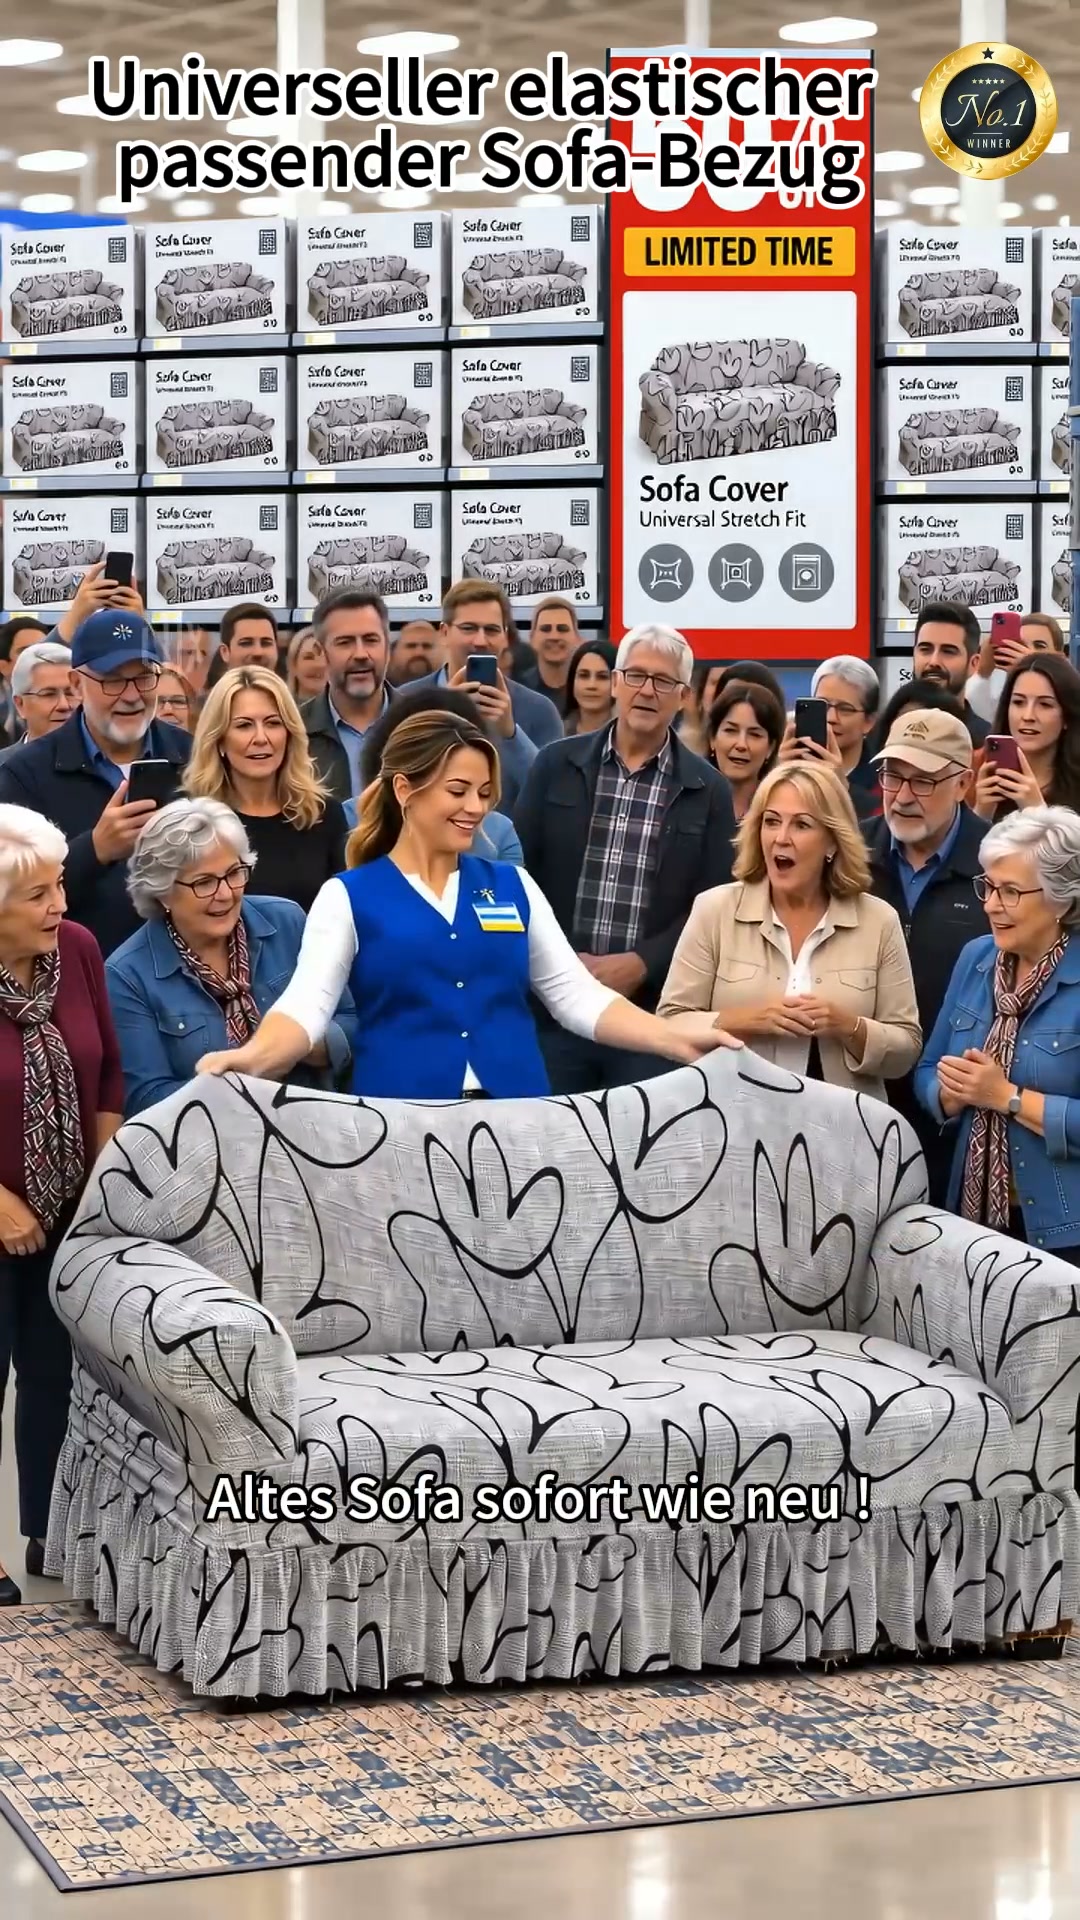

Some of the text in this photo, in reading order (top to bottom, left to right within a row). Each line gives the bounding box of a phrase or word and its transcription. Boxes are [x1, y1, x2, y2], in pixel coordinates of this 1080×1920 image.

[645, 236, 833, 266] LIMITED TIME
[639, 475, 789, 503] Sofa Cover
[639, 509, 807, 528] Universal Stretch Fit
